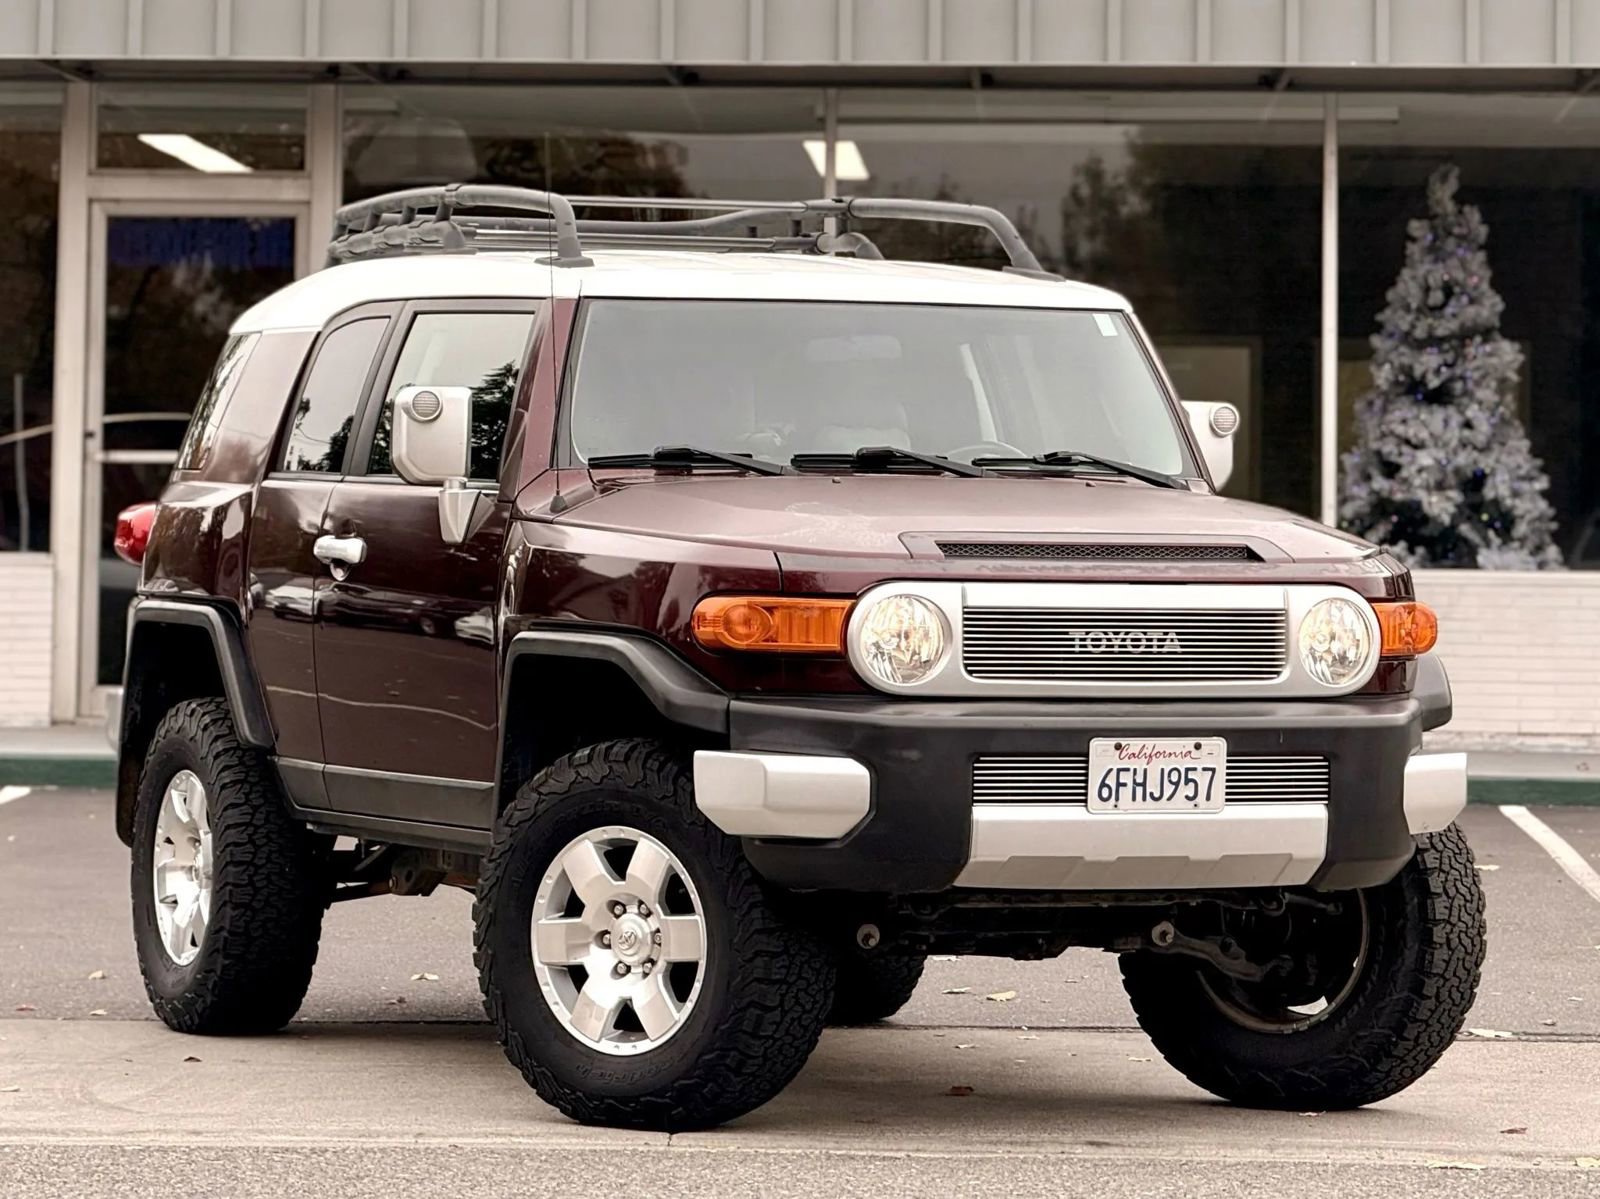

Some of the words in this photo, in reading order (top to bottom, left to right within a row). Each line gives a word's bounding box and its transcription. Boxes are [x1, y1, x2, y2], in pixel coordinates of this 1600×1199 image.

[1068, 631, 1182, 653] TOYOTA
[1118, 743, 1201, 765] California
[1097, 767, 1216, 802] 6FHJ957
